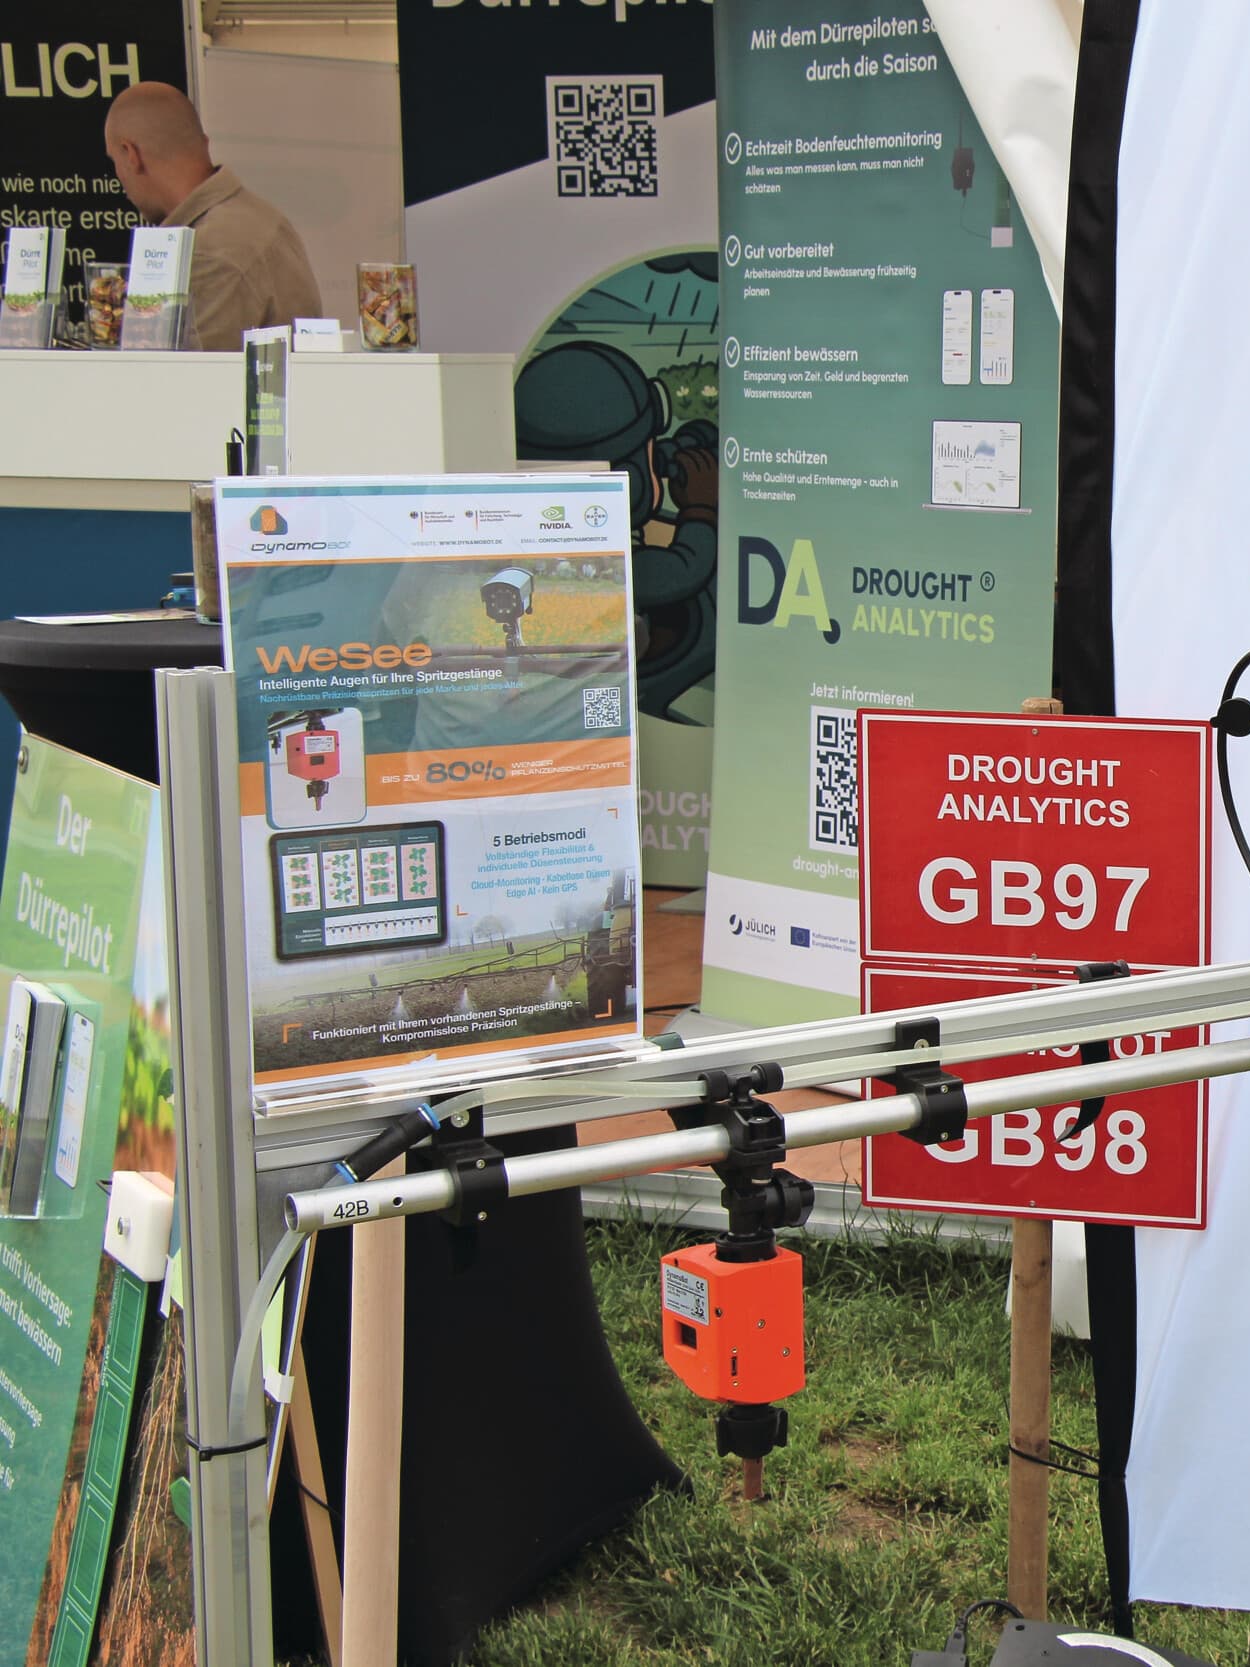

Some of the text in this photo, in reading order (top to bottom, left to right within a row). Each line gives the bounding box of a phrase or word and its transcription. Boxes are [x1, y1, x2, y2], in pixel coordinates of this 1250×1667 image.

[751, 16, 917, 50] Mit dem Dürrepiloten
[1, 42, 140, 98] LICH
[806, 52, 937, 81] durch die Saison
[746, 130, 942, 157] Echtzeit Bodenfeuchtemonitoring
[746, 165, 764, 176] Alles
[766, 166, 783, 175] was
[785, 165, 803, 174] man
[805, 163, 835, 173] messen
[860, 160, 881, 169] muss
[883, 158, 901, 168] man
[903, 156, 924, 168] nicht
[2, 173, 34, 193] wie
[40, 174, 86, 193] noch
[745, 182, 780, 194] schätzen
[744, 242, 834, 259] Gut vorbereitet
[744, 264, 917, 279] Arbeitseinsätze und Bewässerung frühzeitig
[744, 286, 770, 299] planen
[744, 345, 858, 362] Effizient bewässern
[744, 370, 786, 384] Einsparung
[788, 373, 803, 382] von
[824, 371, 843, 382] Geld
[845, 371, 860, 382] und
[861, 371, 909, 385] begrenzten
[744, 388, 812, 400] Wasserressourcen
[743, 448, 828, 465] Ernte schützen
[743, 472, 762, 482] Hohe
[763, 472, 795, 484] Qualität
[797, 474, 812, 484] und
[814, 474, 862, 489] Erntemenge
[869, 477, 889, 489] auch
[891, 478, 898, 489] in
[743, 489, 796, 501] Trockenzeiten
[852, 567, 972, 602] DROUGHT
[852, 604, 994, 643] ANALYTICS
[256, 643, 432, 674] WeSee
[259, 667, 502, 691] Intelligente Augen für Ihre Spritzgestänge
[810, 682, 914, 707] Jetzt informieren!
[382, 776, 400, 784] BIS
[425, 760, 506, 784] 80%
[947, 754, 1121, 788] DROUGHT
[937, 793, 1130, 828] ANALYTICS
[57, 794, 93, 856] Der
[493, 827, 586, 847] 5 Betriebsmodi
[478, 854, 603, 873] individuelle Düsensteuerung
[485, 848, 540, 862] Vollständige
[562, 883, 578, 892] GPS
[918, 857, 1150, 932] GB97
[16, 871, 113, 974] Dürrepilot
[745, 918, 776, 936] JÜLICH
[313, 1023, 377, 1041] Funktioniert
[379, 1021, 397, 1032] mit
[399, 1017, 428, 1030] Ihrem
[430, 1010, 496, 1026] vorhandenen
[499, 1000, 573, 1016] Spritzgestänge
[382, 1017, 518, 1044] Kompromisslose Präzision
[333, 1200, 369, 1219] 42B
